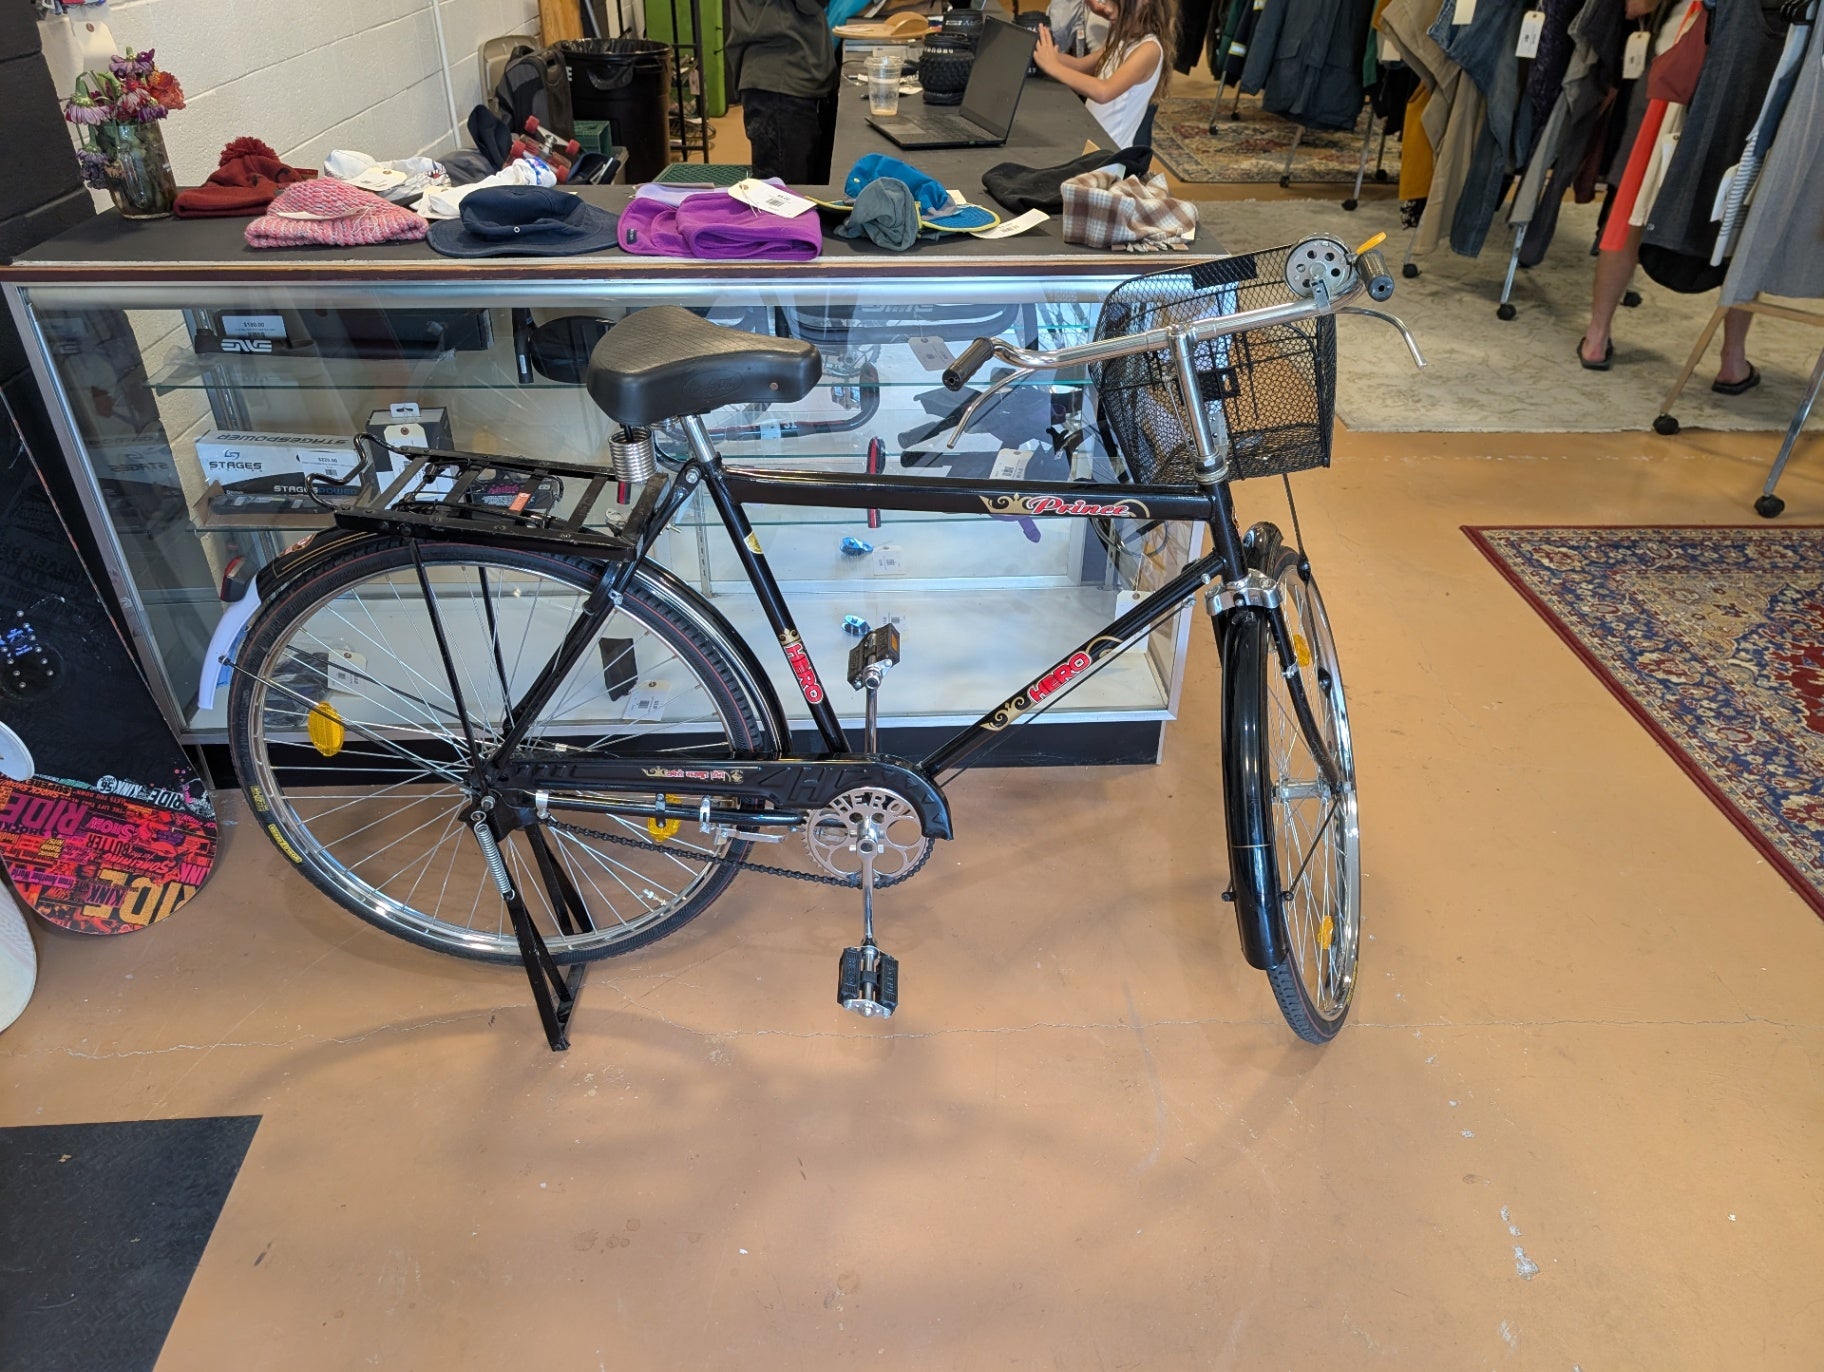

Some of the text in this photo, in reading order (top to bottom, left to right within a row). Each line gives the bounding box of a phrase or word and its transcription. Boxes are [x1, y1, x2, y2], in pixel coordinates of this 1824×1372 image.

[209, 461, 262, 470] STAGES
[1026, 495, 1130, 516] Prince
[784, 642, 823, 704] HERO
[1028, 650, 1092, 704] HERO
[100, 781, 112, 792] 56
[114, 780, 143, 798] KINK
[149, 786, 185, 811] RIDE
[0, 792, 88, 835] RIDE
[832, 792, 906, 816] HERO
[87, 833, 130, 856] BUTTER
[102, 852, 177, 874] SOMETHING
[180, 862, 210, 887] INK
[85, 882, 127, 908] KINK
